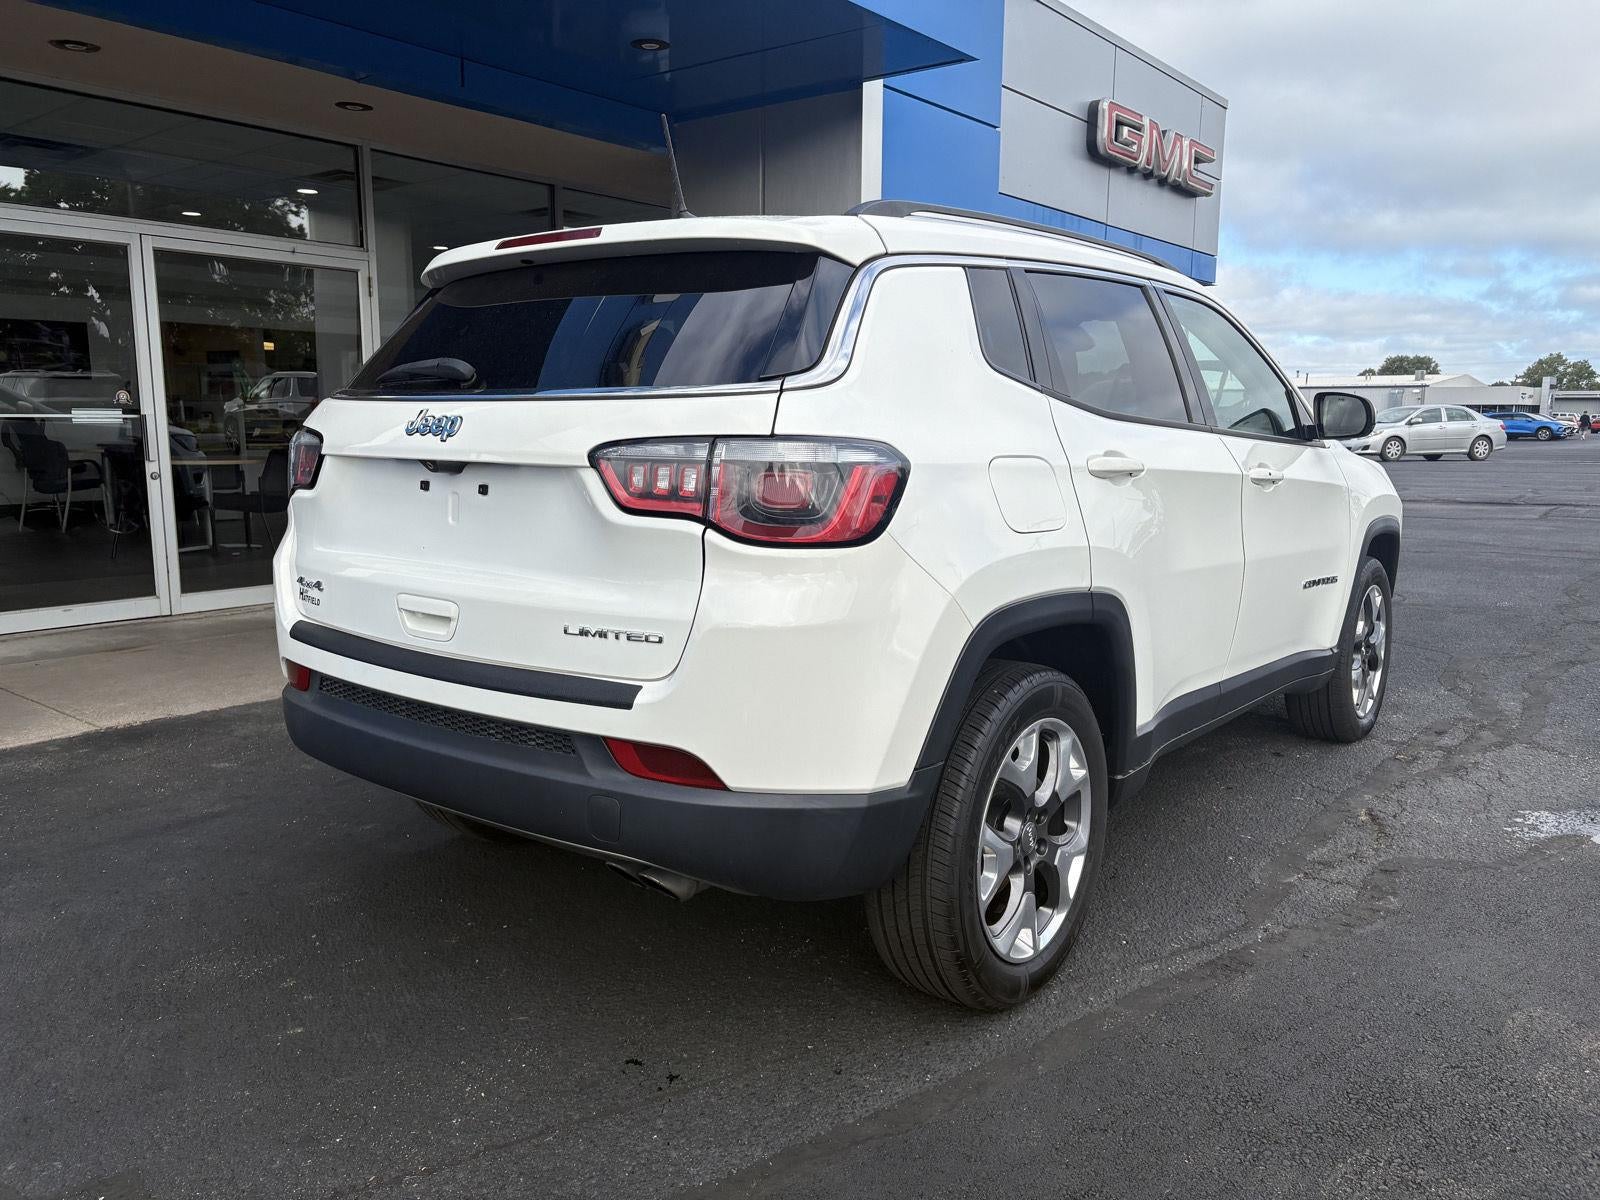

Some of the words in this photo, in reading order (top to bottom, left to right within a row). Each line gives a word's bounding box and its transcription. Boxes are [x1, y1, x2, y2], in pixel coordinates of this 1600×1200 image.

[1090, 98, 1216, 197] GMC
[405, 408, 464, 442] Jeep
[563, 624, 664, 644] LIMITED
